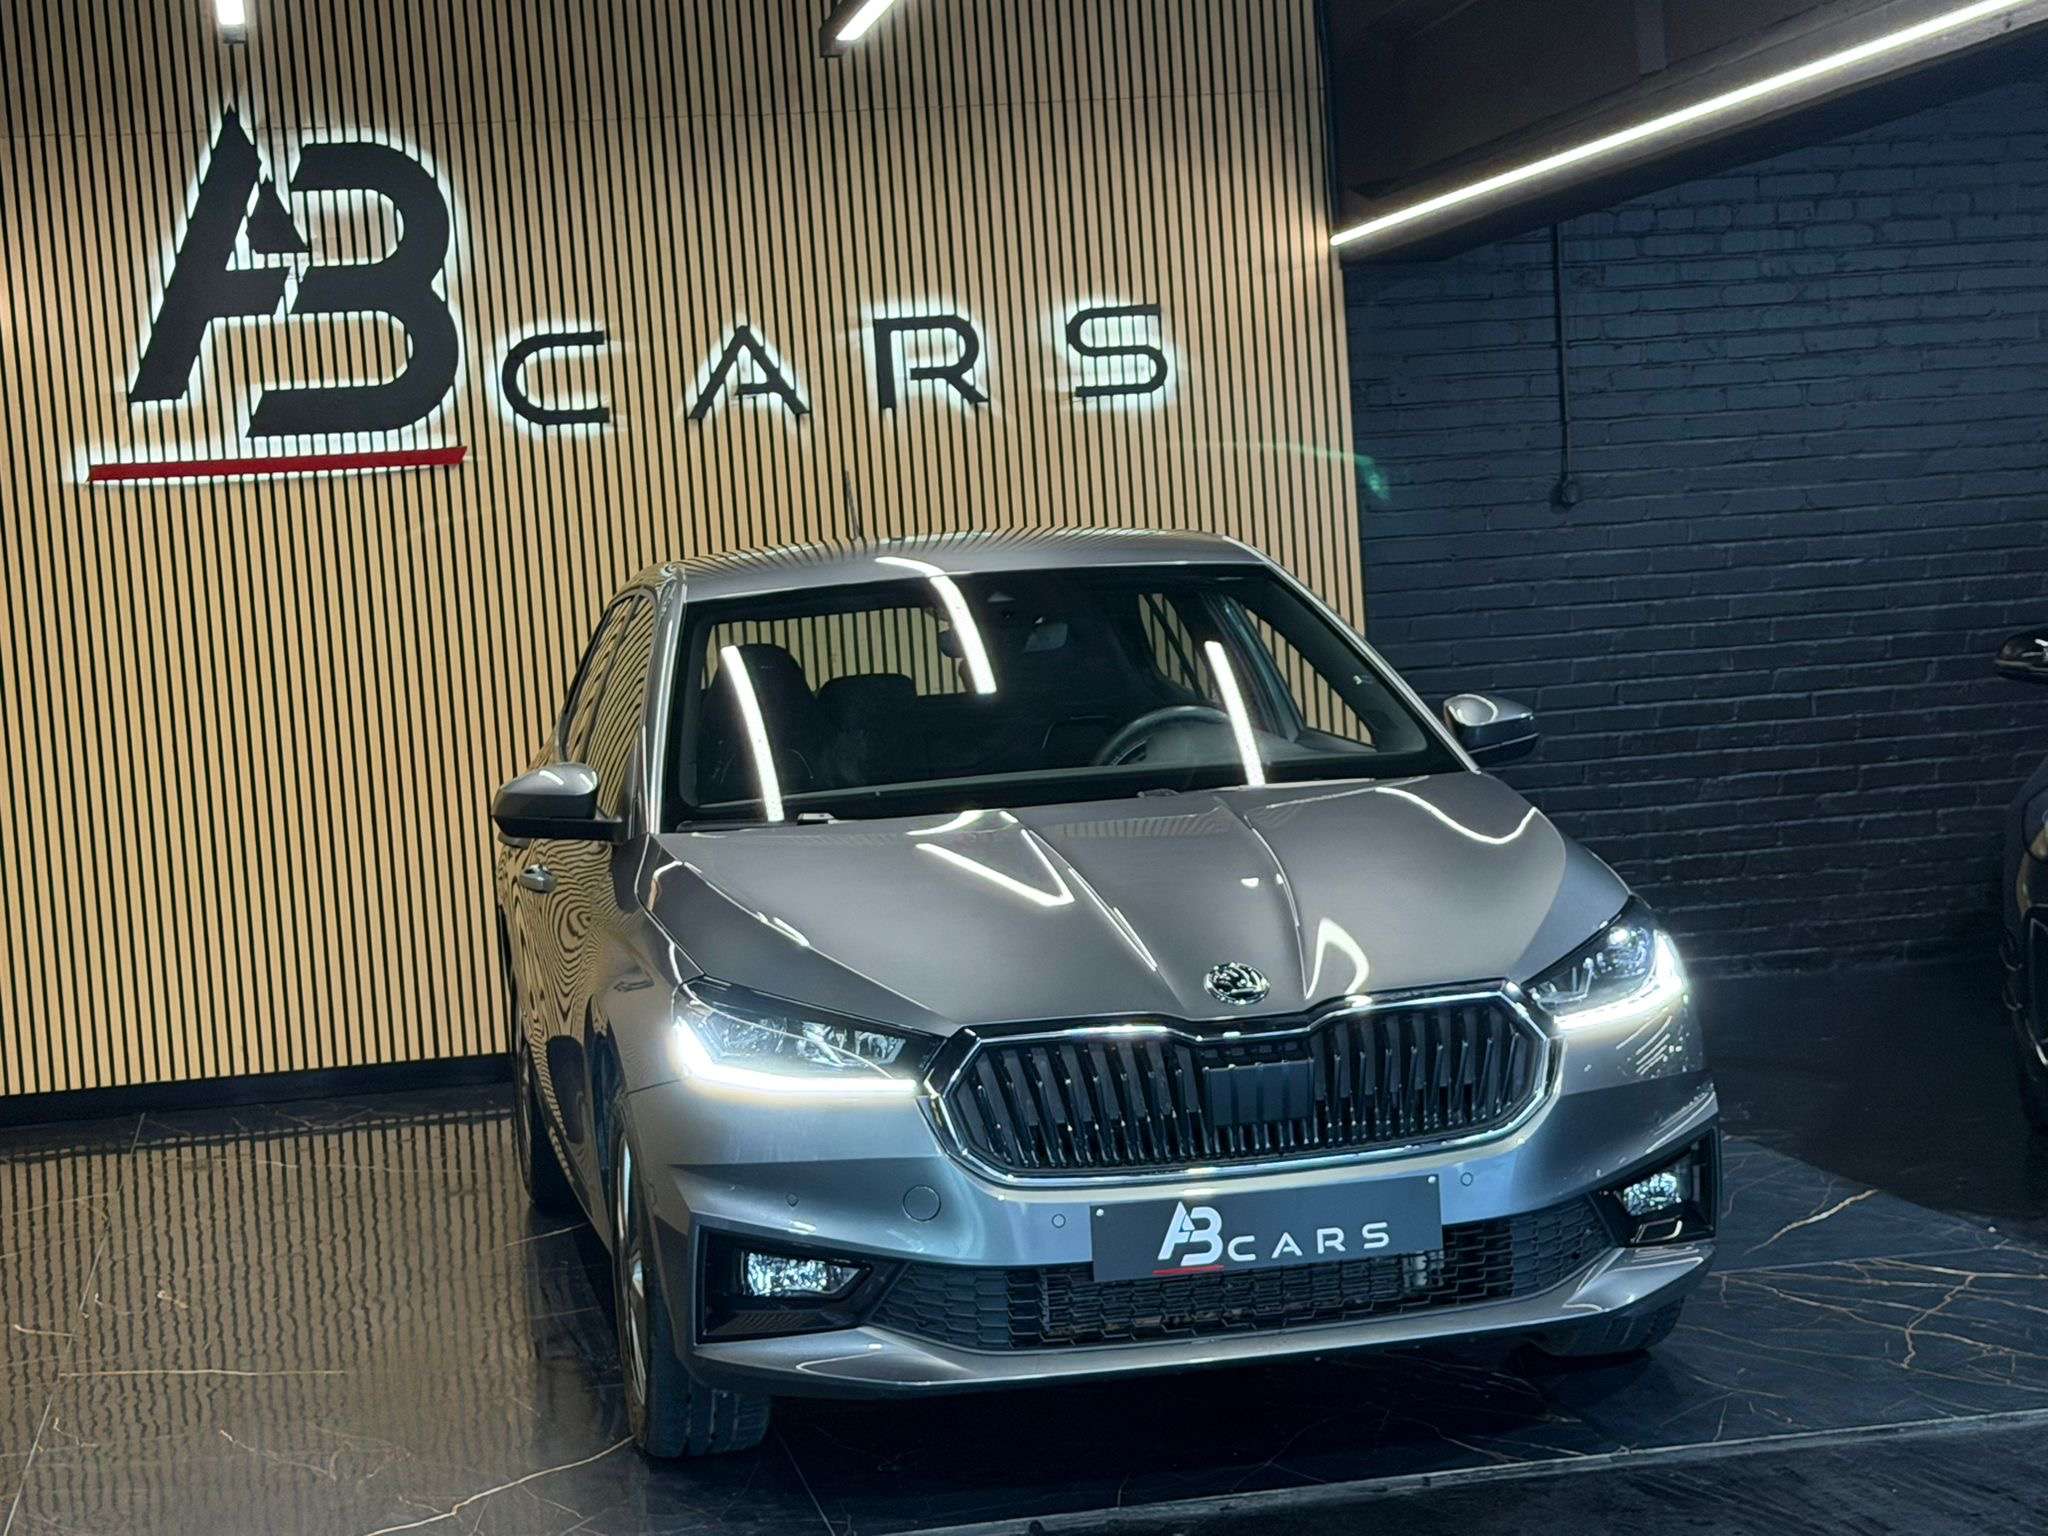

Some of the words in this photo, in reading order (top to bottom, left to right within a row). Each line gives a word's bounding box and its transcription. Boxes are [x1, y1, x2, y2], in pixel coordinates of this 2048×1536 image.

[128, 105, 460, 437] AB
[502, 303, 1168, 426] CARS
[1157, 1200, 1224, 1267] AB
[1227, 1221, 1390, 1262] CARS
